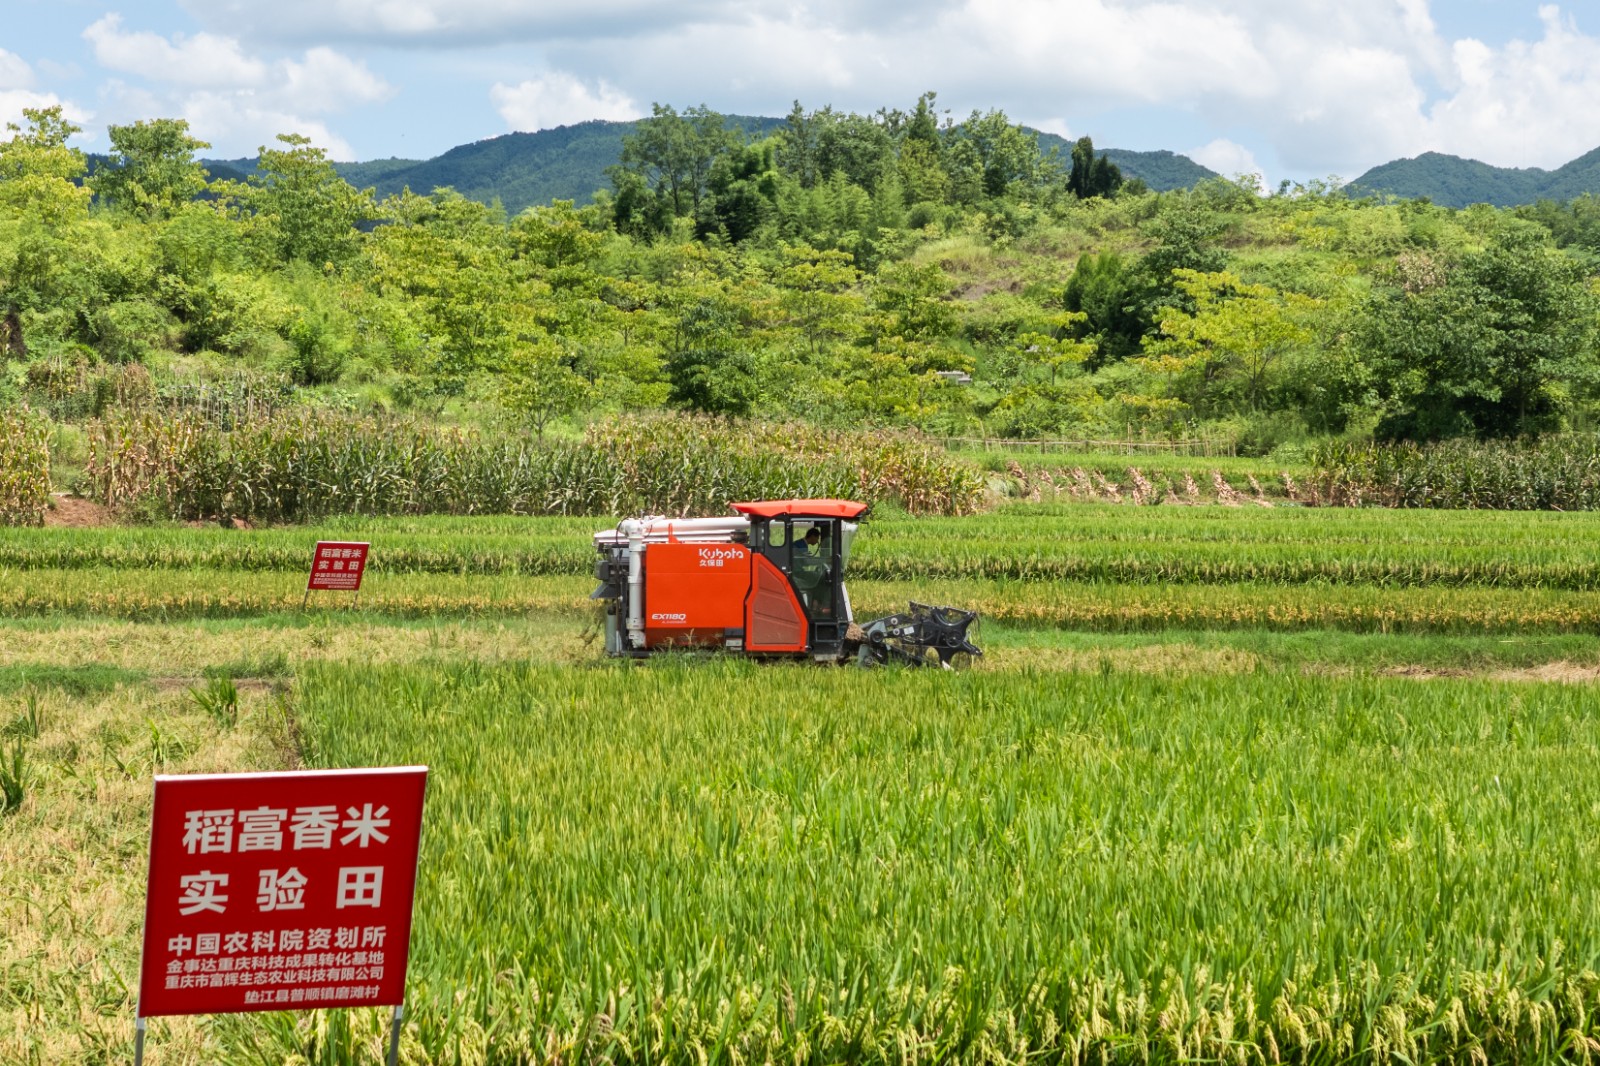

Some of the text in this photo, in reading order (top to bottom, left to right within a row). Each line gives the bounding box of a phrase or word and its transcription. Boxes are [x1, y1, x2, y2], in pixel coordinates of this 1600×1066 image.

[698, 548, 744, 559] Kubota
[699, 559, 724, 567] 久保田
[182, 803, 391, 855] 稻富香米
[178, 866, 384, 916] 实验田
[167, 925, 386, 957] 中国农科院资划所
[166, 950, 384, 974] 金事达重庆科技成果转化基地
[164, 966, 384, 989] 重庆市富辉生态农业科技有限公司
